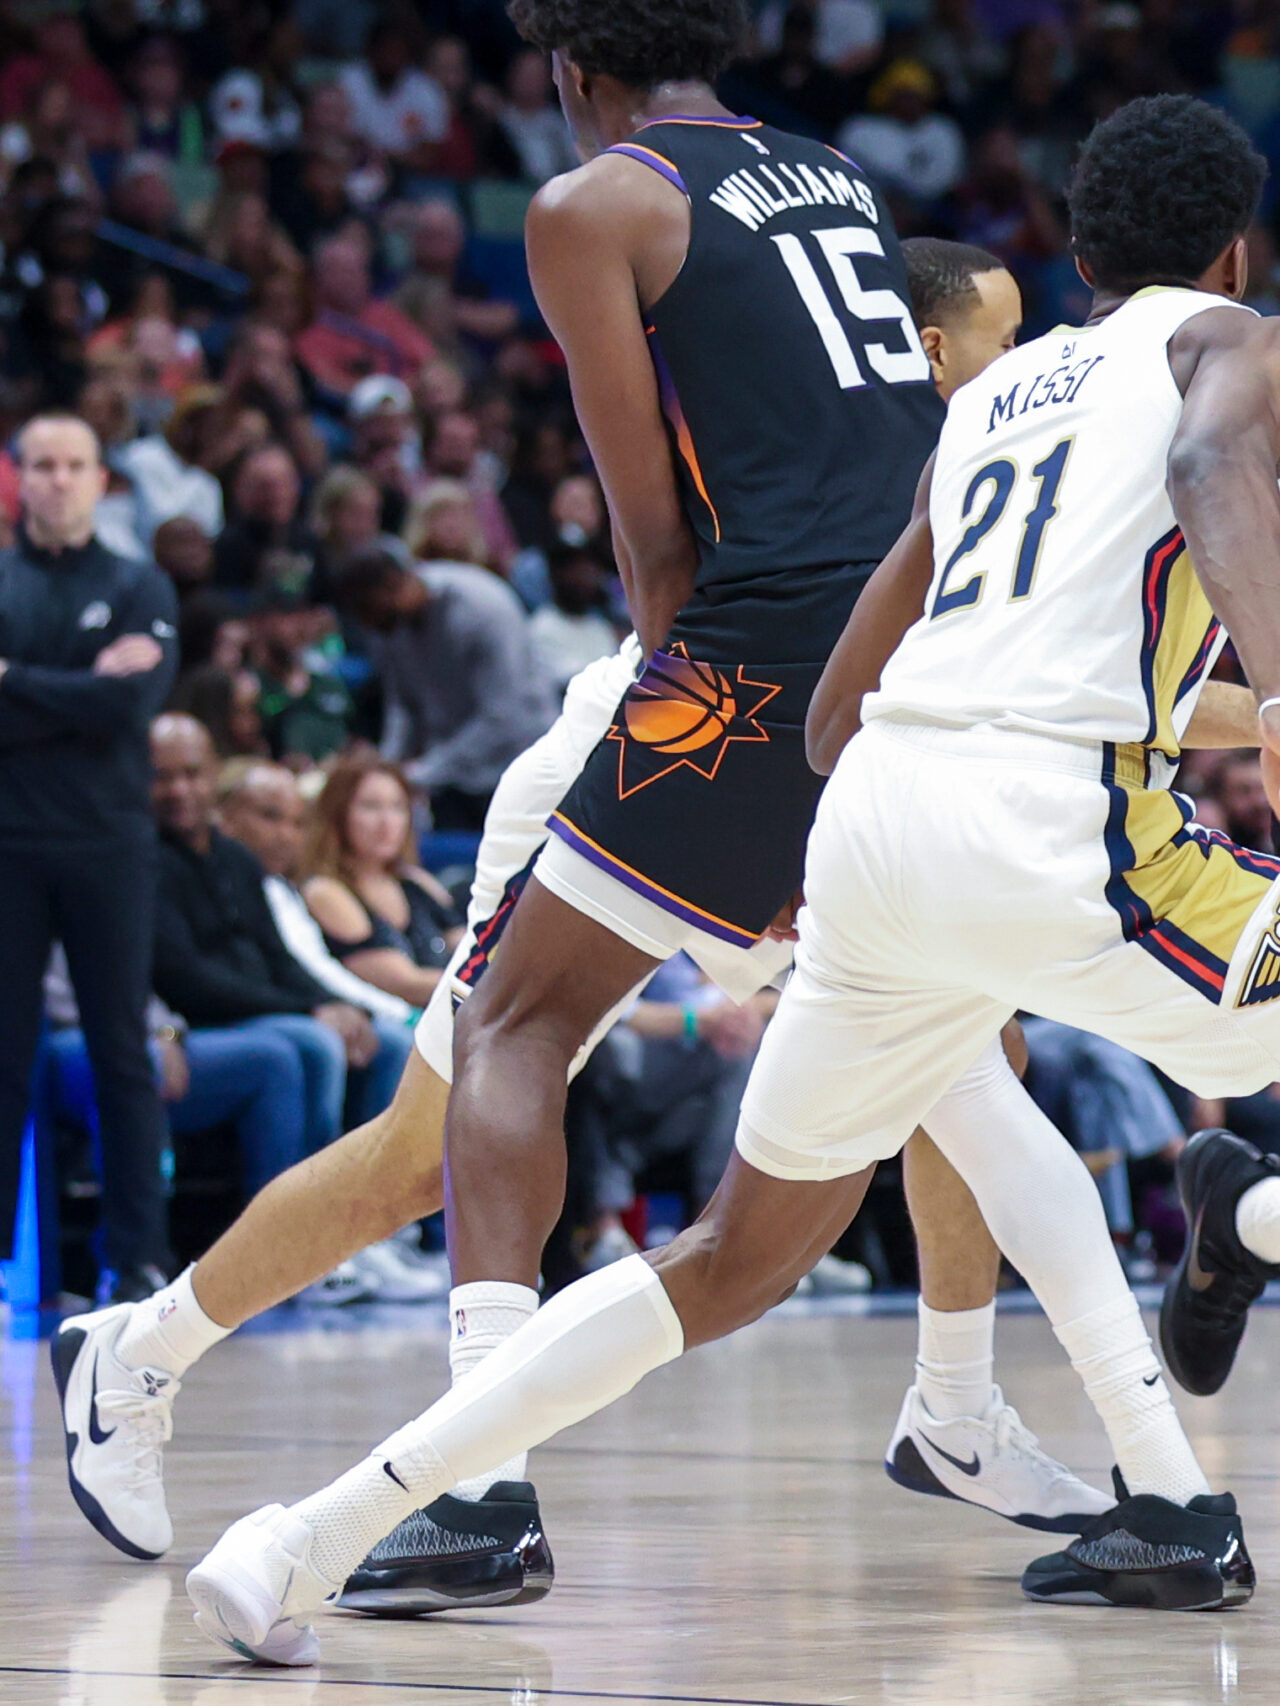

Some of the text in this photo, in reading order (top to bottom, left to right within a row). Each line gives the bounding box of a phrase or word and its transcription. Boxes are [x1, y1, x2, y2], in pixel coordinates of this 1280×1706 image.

[708, 162, 879, 232] WILLIAMS
[769, 226, 931, 390] 15
[986, 355, 1105, 435] MISSI
[929, 434, 1077, 622] 21
